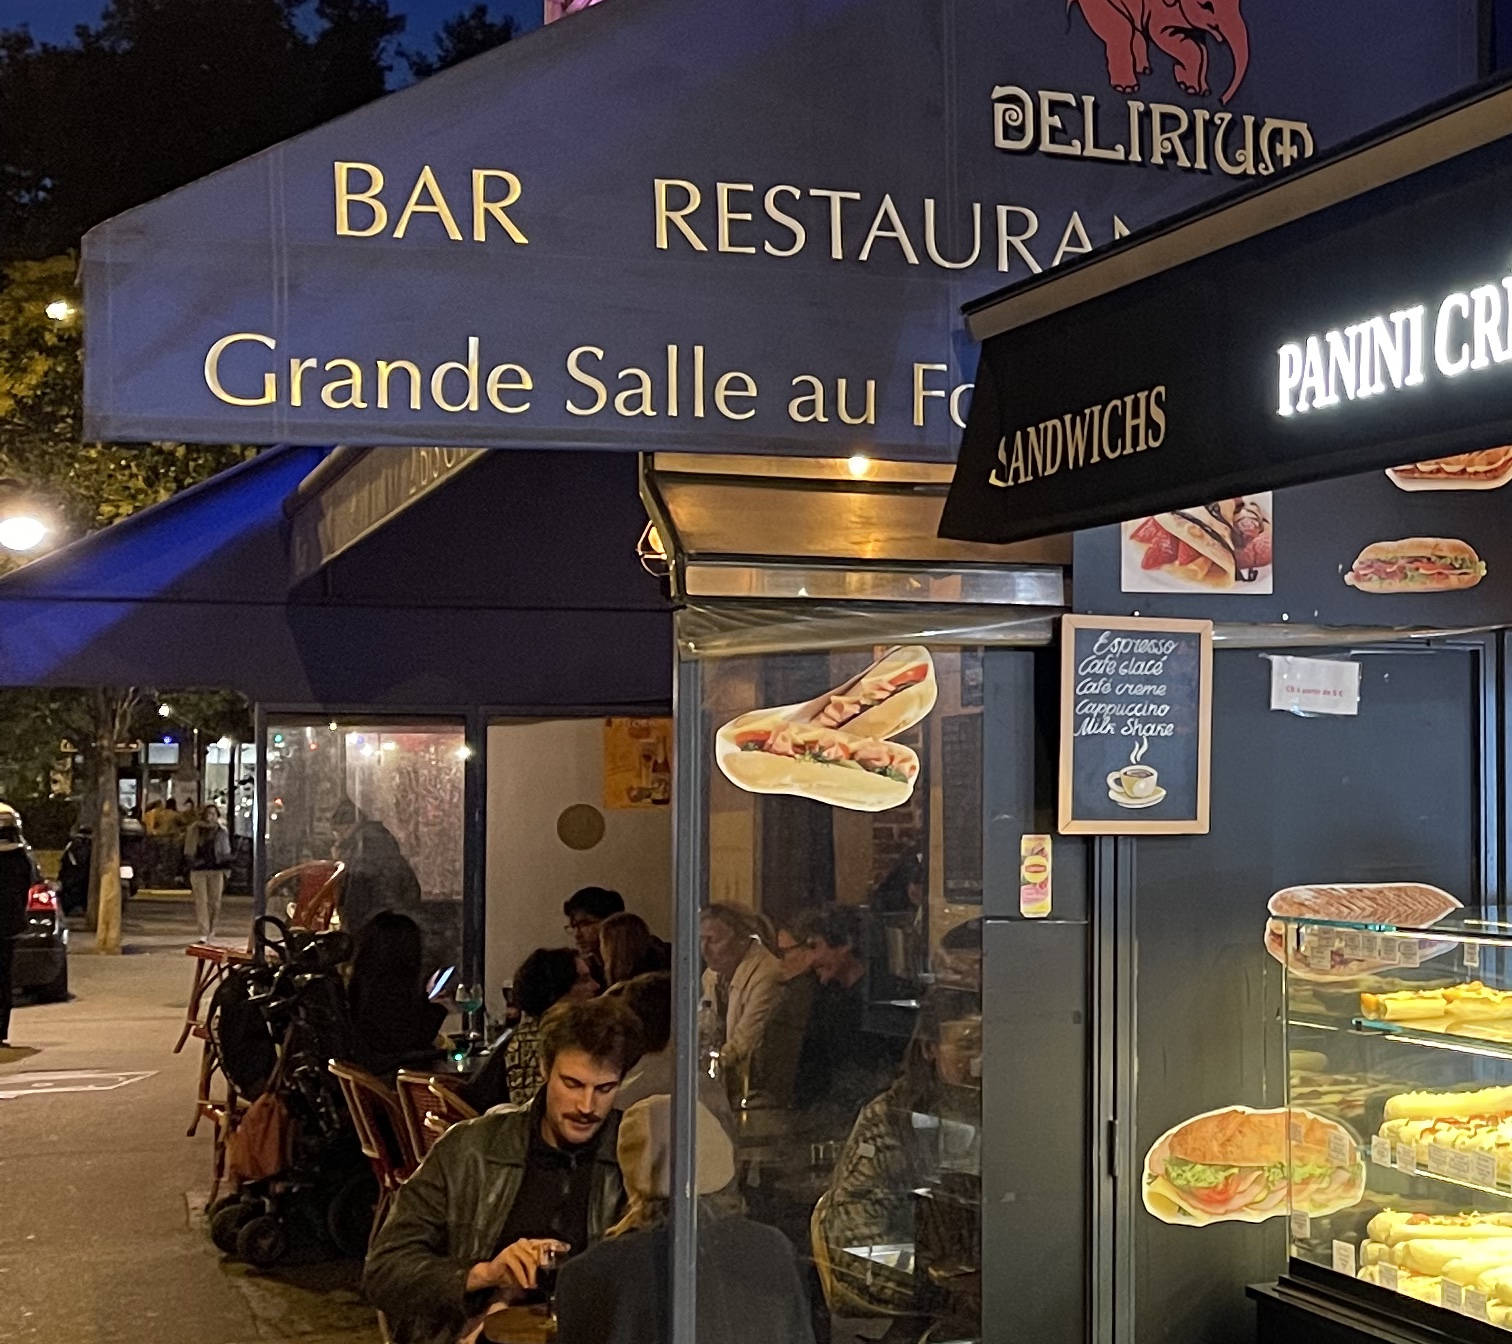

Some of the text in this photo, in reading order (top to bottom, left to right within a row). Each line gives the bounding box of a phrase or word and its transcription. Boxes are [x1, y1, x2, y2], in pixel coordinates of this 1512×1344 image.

[990, 86, 1314, 176] DELIRIUM
[333, 160, 1131, 273] BAR RESTAURA
[204, 332, 534, 414] Grande
[565, 344, 758, 420] Salle
[786, 372, 877, 425] au
[1276, 303, 1427, 417] PANINI
[988, 385, 1168, 487] SANDWICHS
[1093, 631, 1178, 657] Espresso
[1074, 715, 1115, 736] Milk
[1075, 699, 1170, 719] Cappuccino
